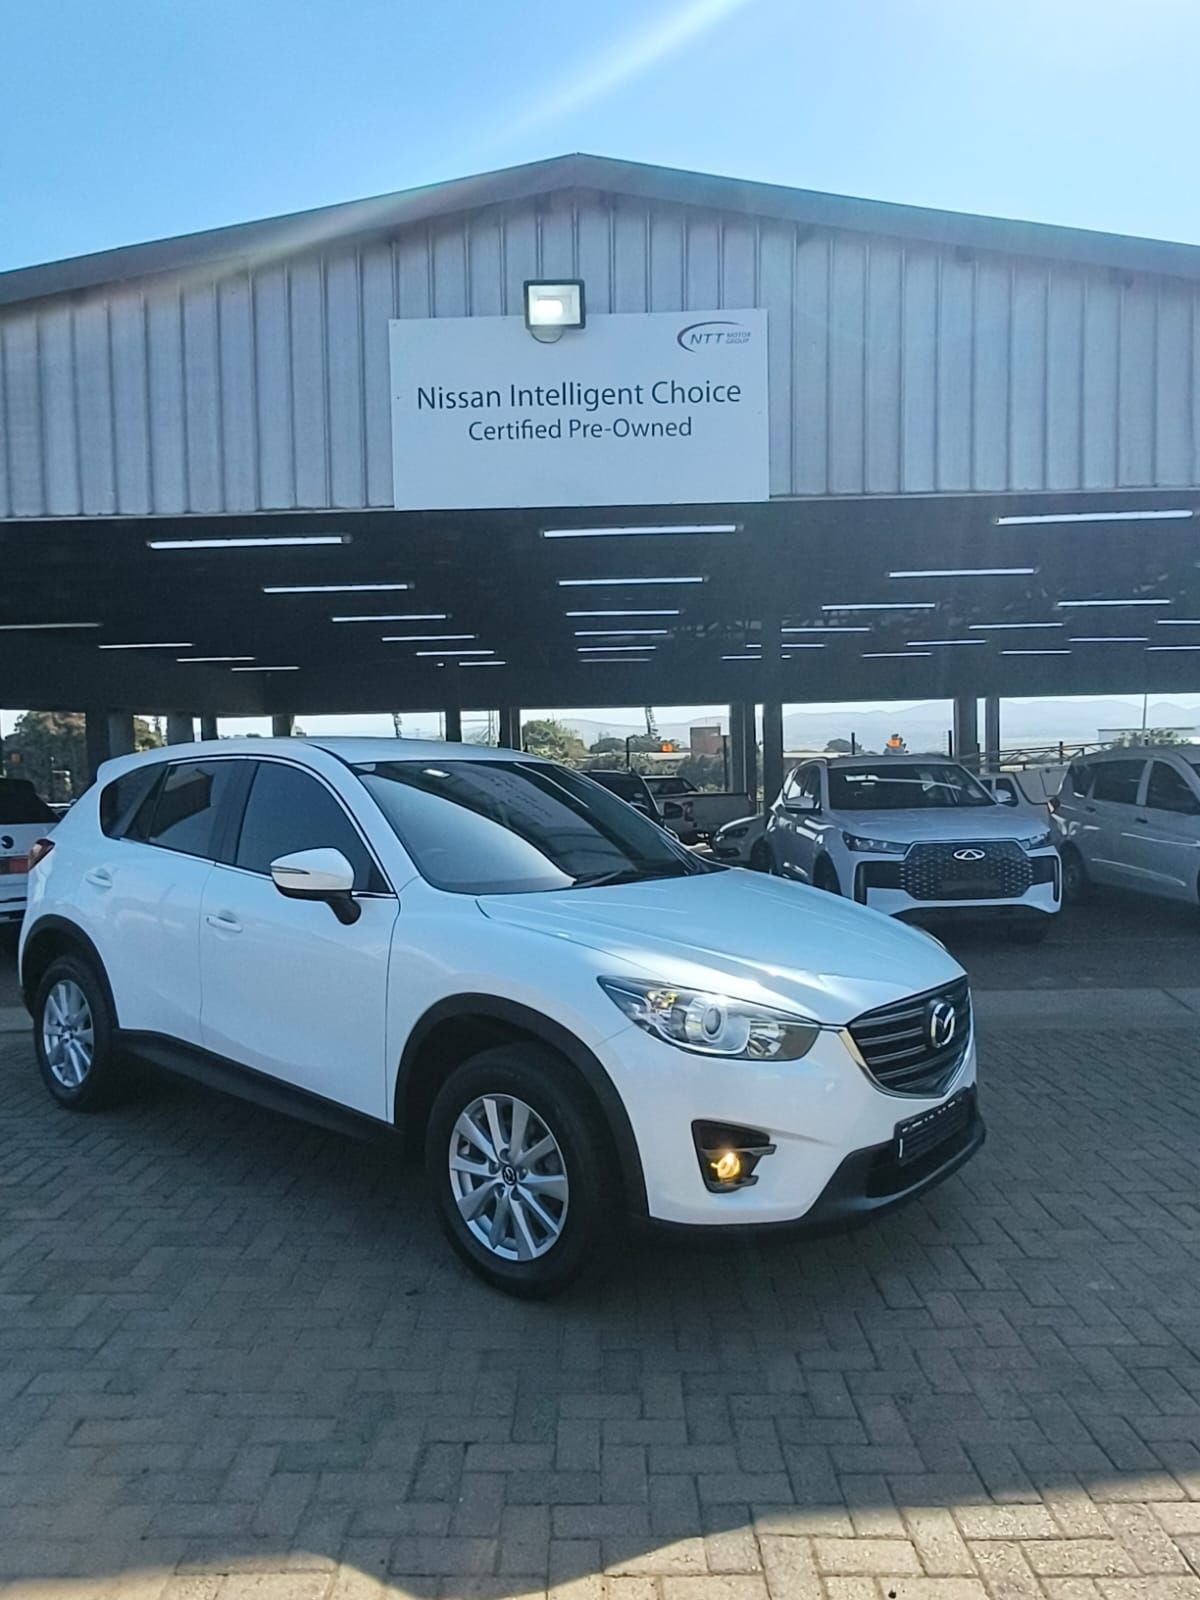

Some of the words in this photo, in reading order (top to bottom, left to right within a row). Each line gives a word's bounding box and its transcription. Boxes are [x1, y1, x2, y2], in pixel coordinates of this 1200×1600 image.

[690, 332, 725, 345] NTT
[417, 386, 501, 410] Nissan
[510, 383, 643, 411] Intelligent
[651, 380, 742, 405] Choice
[468, 418, 562, 441] Certified
[569, 416, 692, 439] Pre-Owned
